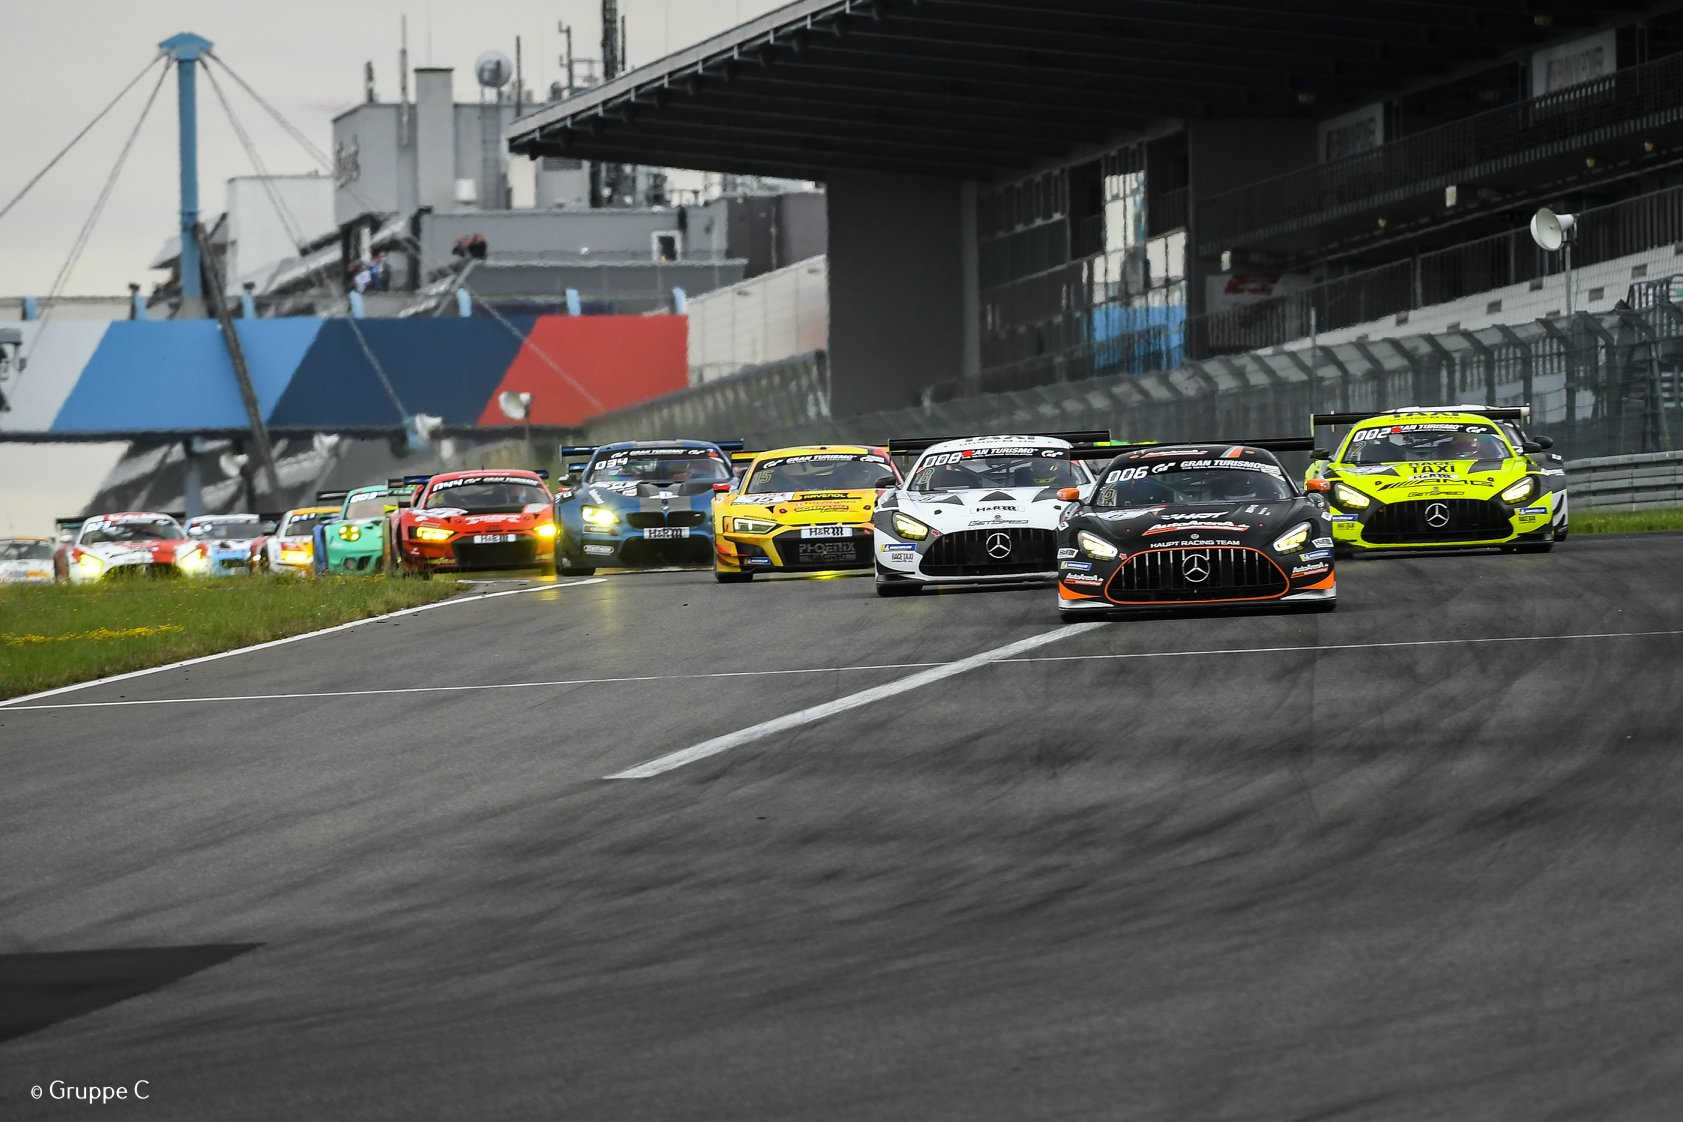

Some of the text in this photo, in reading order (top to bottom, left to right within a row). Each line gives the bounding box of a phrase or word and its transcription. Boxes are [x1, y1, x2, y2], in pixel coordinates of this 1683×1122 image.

[1353, 428, 1391, 442] 002
[991, 447, 1035, 455] TURISMO
[594, 457, 629, 470] 034
[923, 451, 962, 468] 008
[1180, 459, 1261, 469] GRAN TURISMO
[1105, 465, 1150, 484] 006
[1411, 465, 1455, 473] TAXI
[809, 527, 831, 536] H&R
[1150, 538, 1241, 549] HAUPT RACING TEAM
